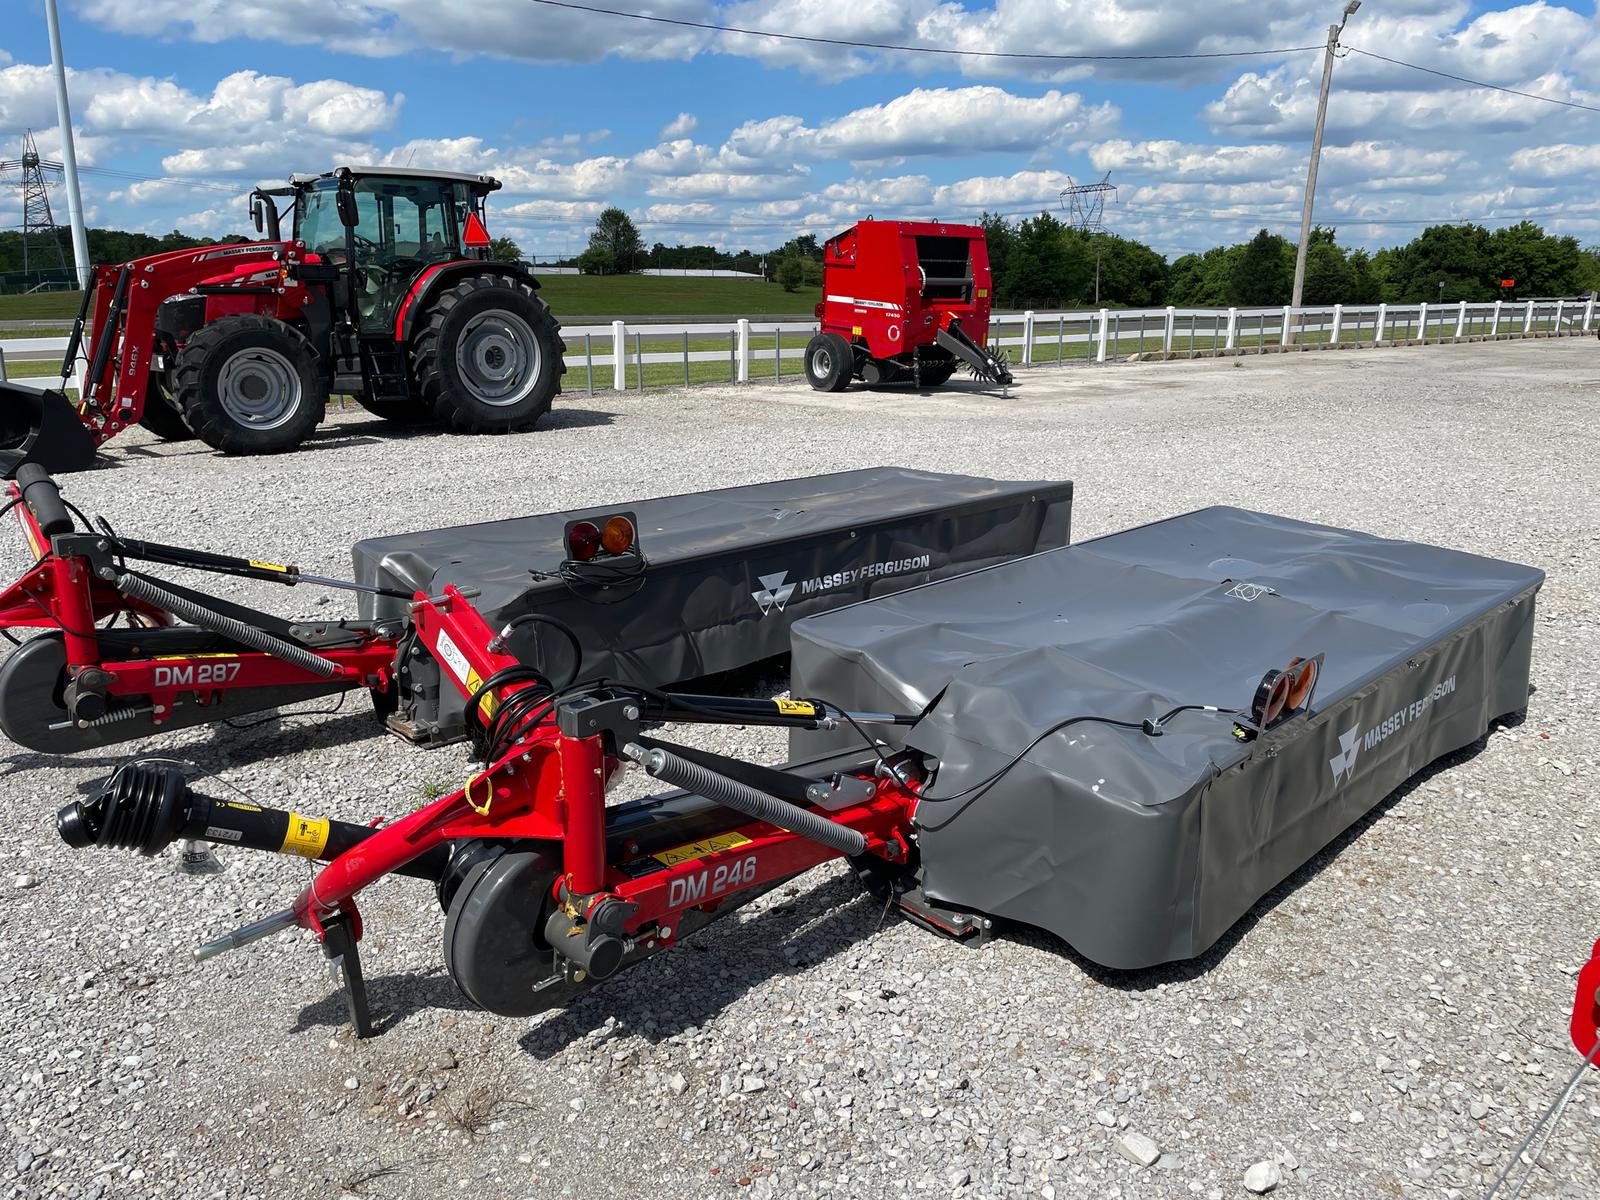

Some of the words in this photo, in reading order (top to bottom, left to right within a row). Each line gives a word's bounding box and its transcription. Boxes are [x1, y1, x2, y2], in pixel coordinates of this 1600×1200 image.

[128, 345, 139, 376] 946X
[801, 568, 859, 595] MASSEY
[859, 554, 930, 580] FERGUSON
[155, 665, 193, 687] DM
[198, 662, 241, 684] 287
[1364, 707, 1407, 752] MASSEY
[1409, 675, 1456, 722] FESON
[669, 871, 708, 907] DM
[712, 857, 757, 893] 246
